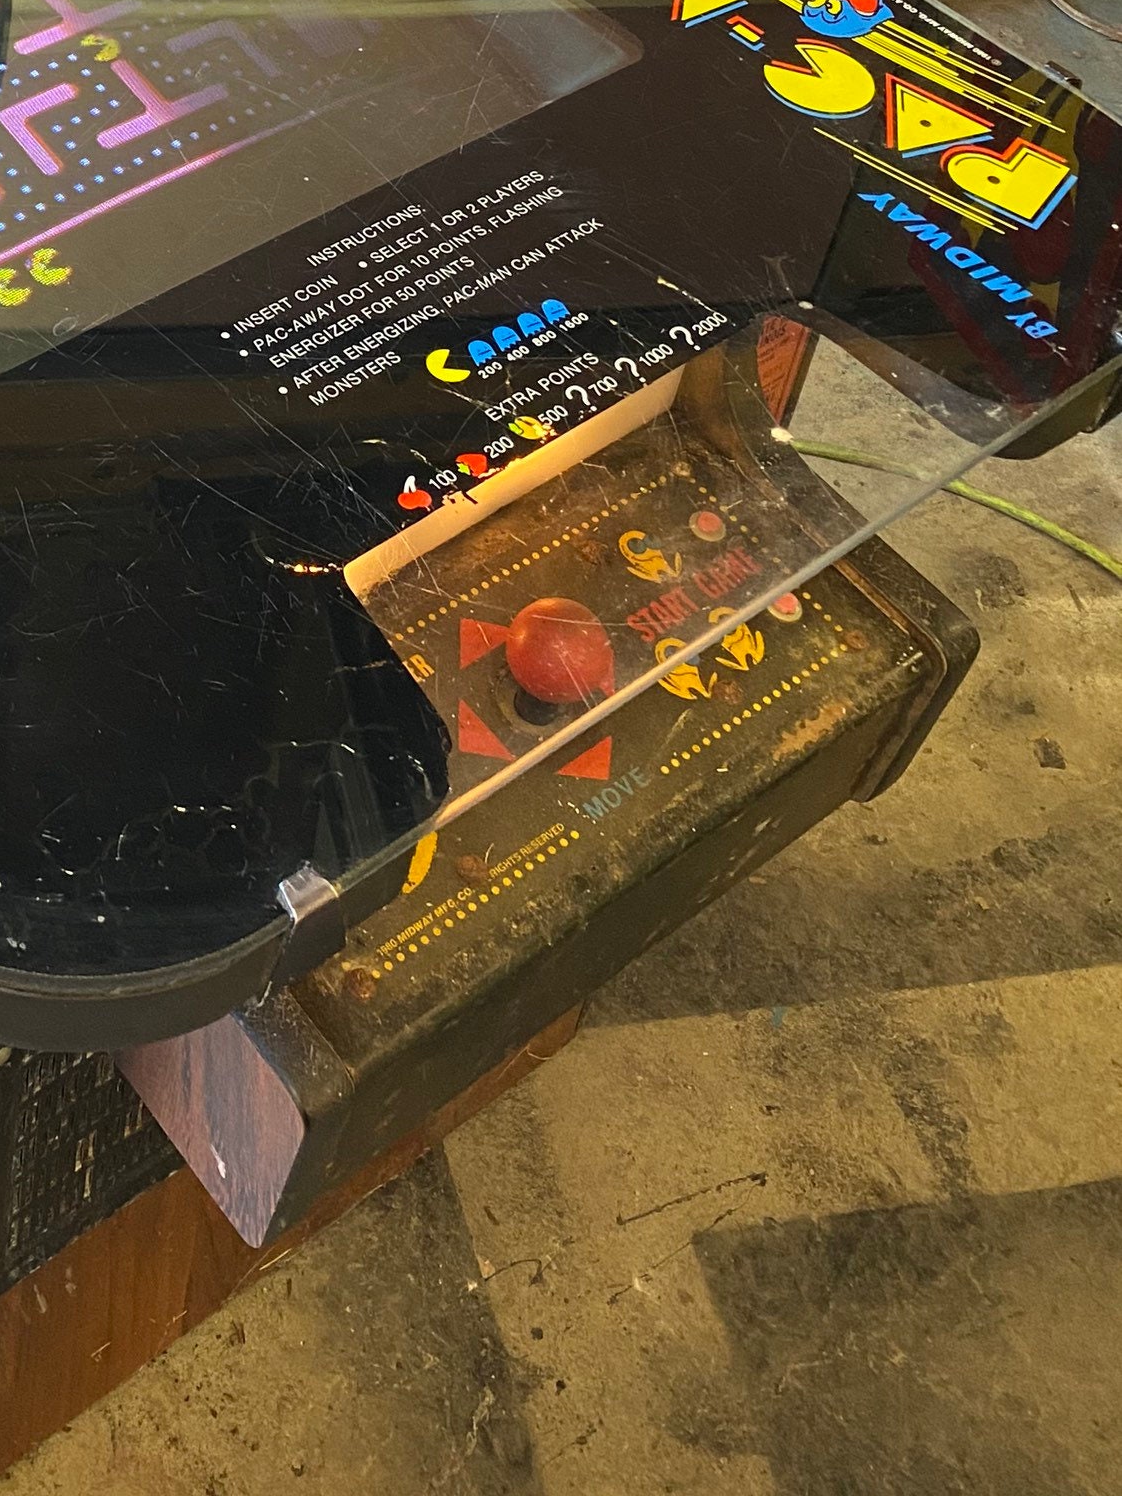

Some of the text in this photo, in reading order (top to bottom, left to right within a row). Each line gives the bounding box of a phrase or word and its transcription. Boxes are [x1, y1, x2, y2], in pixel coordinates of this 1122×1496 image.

[306, 204, 426, 267] INSTRUCTIONS:
[369, 170, 544, 263] SELECT 1 OR 2 PLAYERS
[233, 275, 338, 334] INSERT COIN
[253, 186, 563, 352] PAC-AWAY DOT FOR 10 POINTS, FLASHING
[269, 255, 475, 368] ENERGIZER FOR 50 POINTS
[292, 217, 604, 389] AFTER ENERGIZING, PAC-MAN CAN ATTACK
[856, 192, 1059, 339] BY MIDWAY
[308, 351, 402, 406] MONSTERS
[478, 312, 589, 380] 200 400 800 1600
[484, 352, 600, 422] EXTRA POINTS
[428, 469, 458, 490] 100
[483, 435, 514, 459] 200
[538, 405, 568, 426] 500
[587, 376, 618, 396] 700
[638, 344, 674, 367] 1000
[692, 312, 728, 337] 2000
[626, 546, 764, 642] START GAME
[582, 765, 652, 820] MOVE
[396, 913, 434, 944] MIDWAY
[489, 852, 524, 879] RIGHTS
[519, 823, 565, 857] RESERVED
